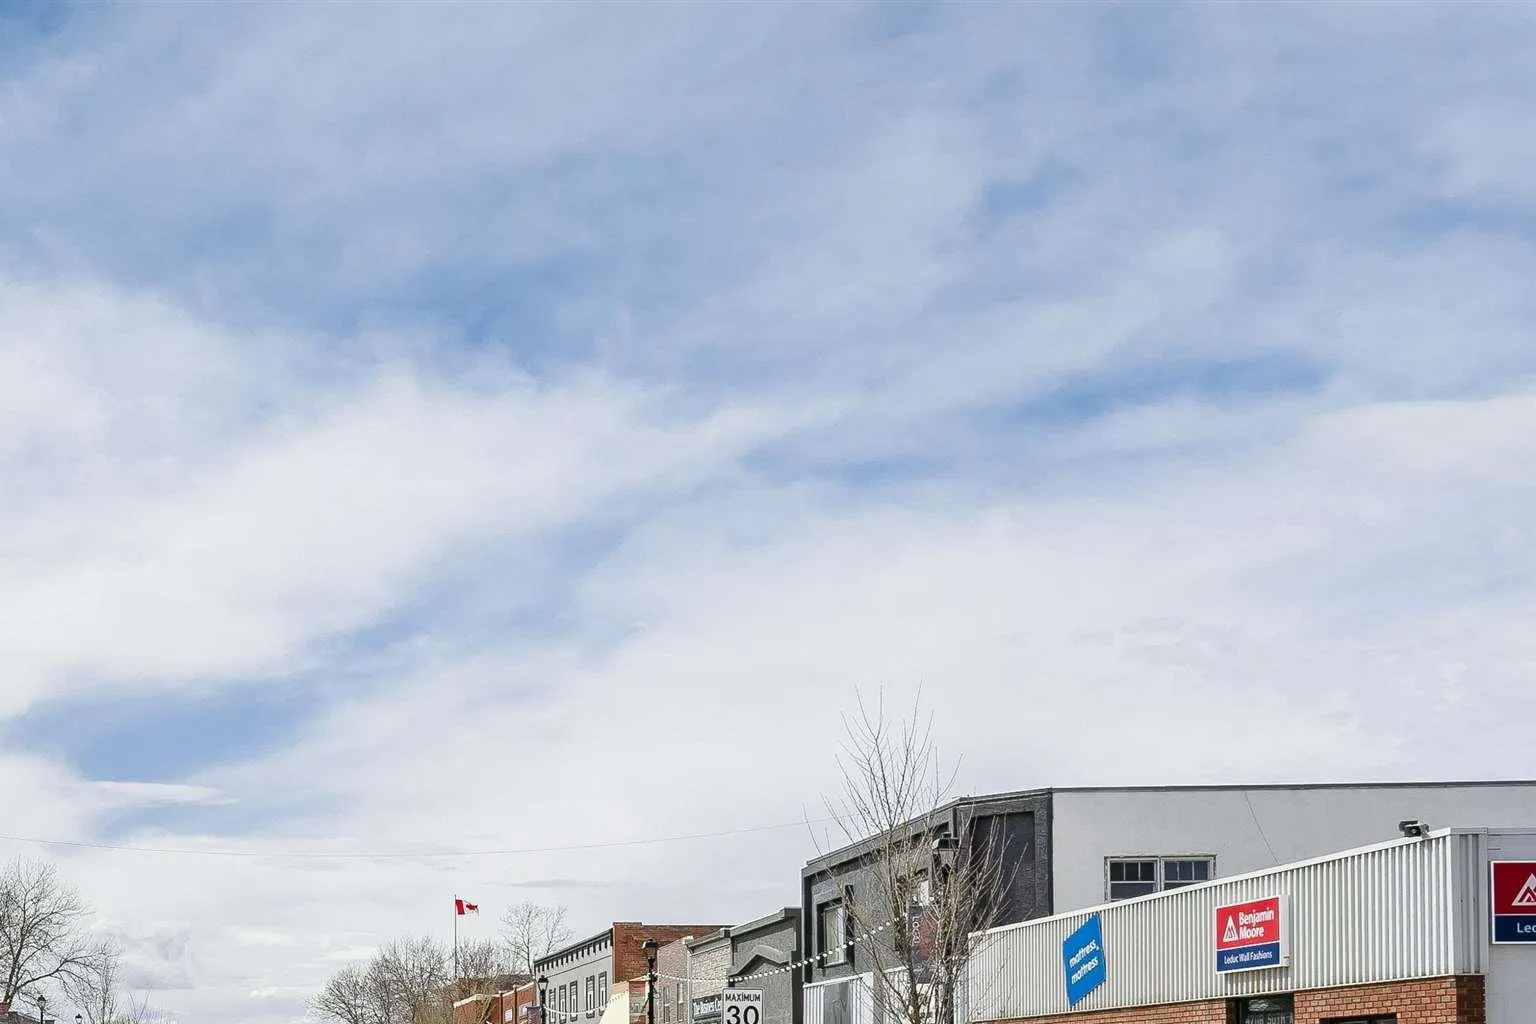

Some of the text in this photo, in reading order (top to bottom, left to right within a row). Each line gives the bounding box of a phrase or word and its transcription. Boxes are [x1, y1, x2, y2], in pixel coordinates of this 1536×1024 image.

[1238, 906, 1275, 927] Benjamin
[1239, 926, 1265, 940] Moore
[1071, 956, 1099, 984] mattress
[725, 993, 761, 1002] MAXIMUM
